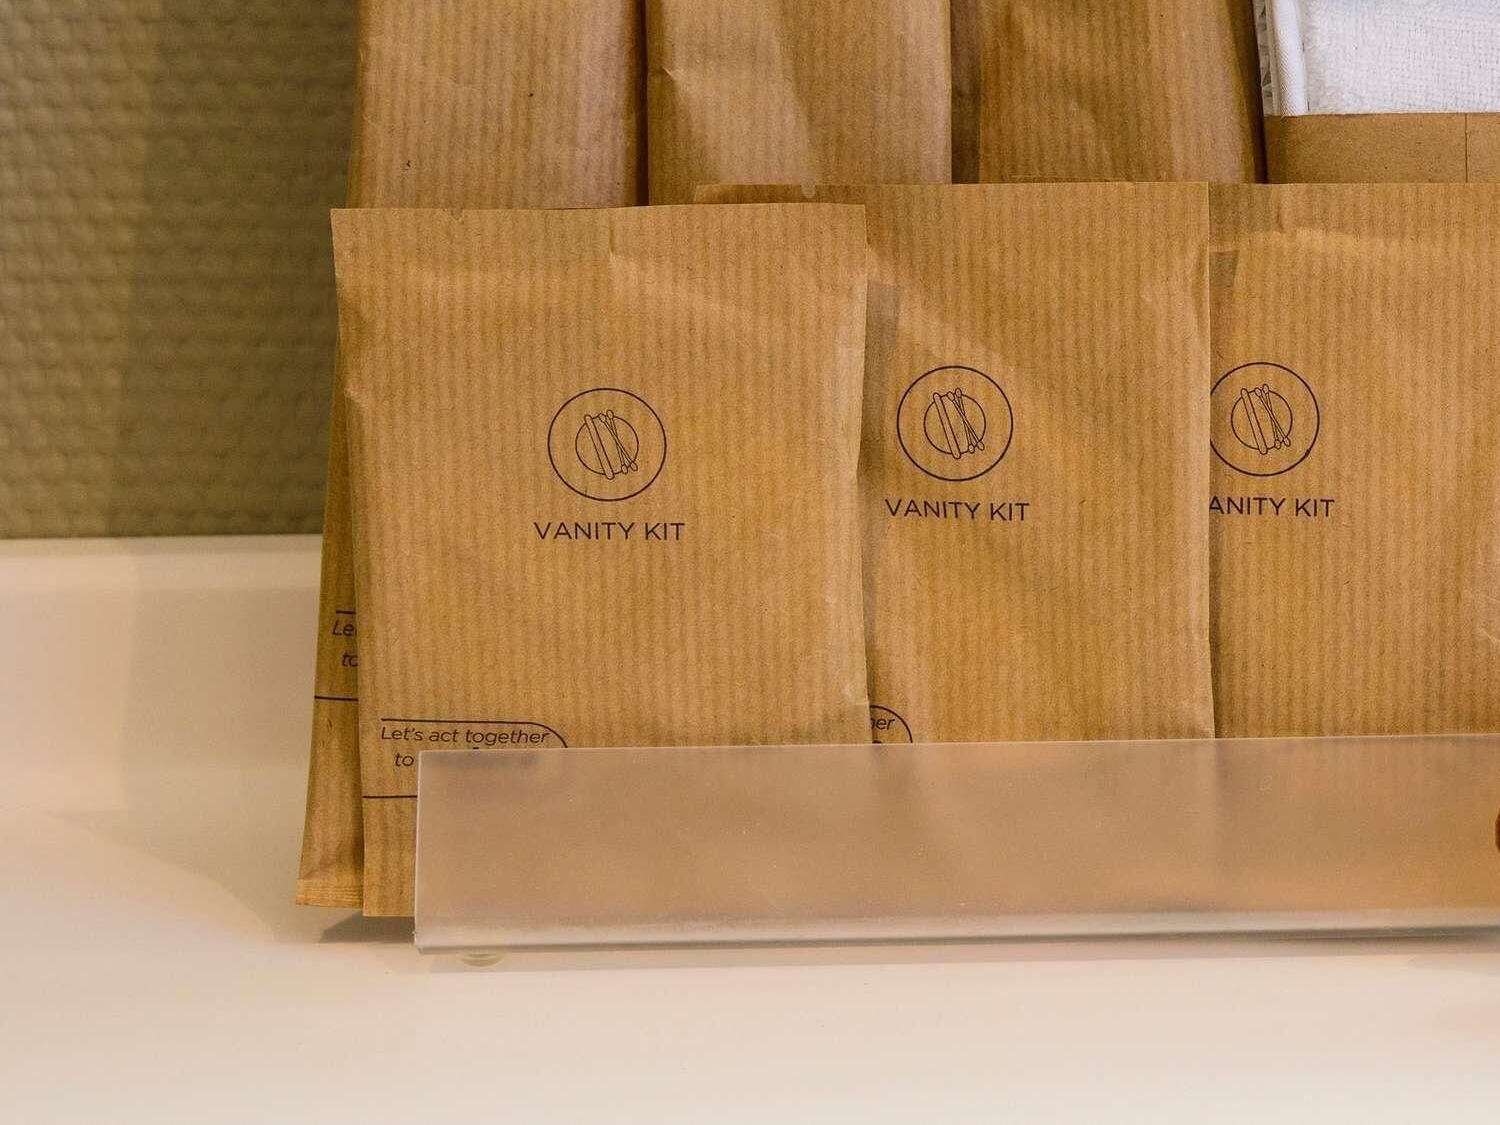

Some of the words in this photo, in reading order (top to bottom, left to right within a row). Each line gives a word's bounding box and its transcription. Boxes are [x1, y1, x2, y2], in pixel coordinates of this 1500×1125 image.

[885, 499, 980, 519] VANITY
[990, 502, 1030, 522] KIT
[1208, 495, 1286, 516] ANITY
[1295, 498, 1335, 518] KIT
[533, 521, 635, 540] VANITY
[644, 522, 686, 541] KIT
[381, 726, 424, 742] Let's
[428, 729, 460, 743] act
[466, 729, 549, 743] together
[394, 752, 415, 768] to
